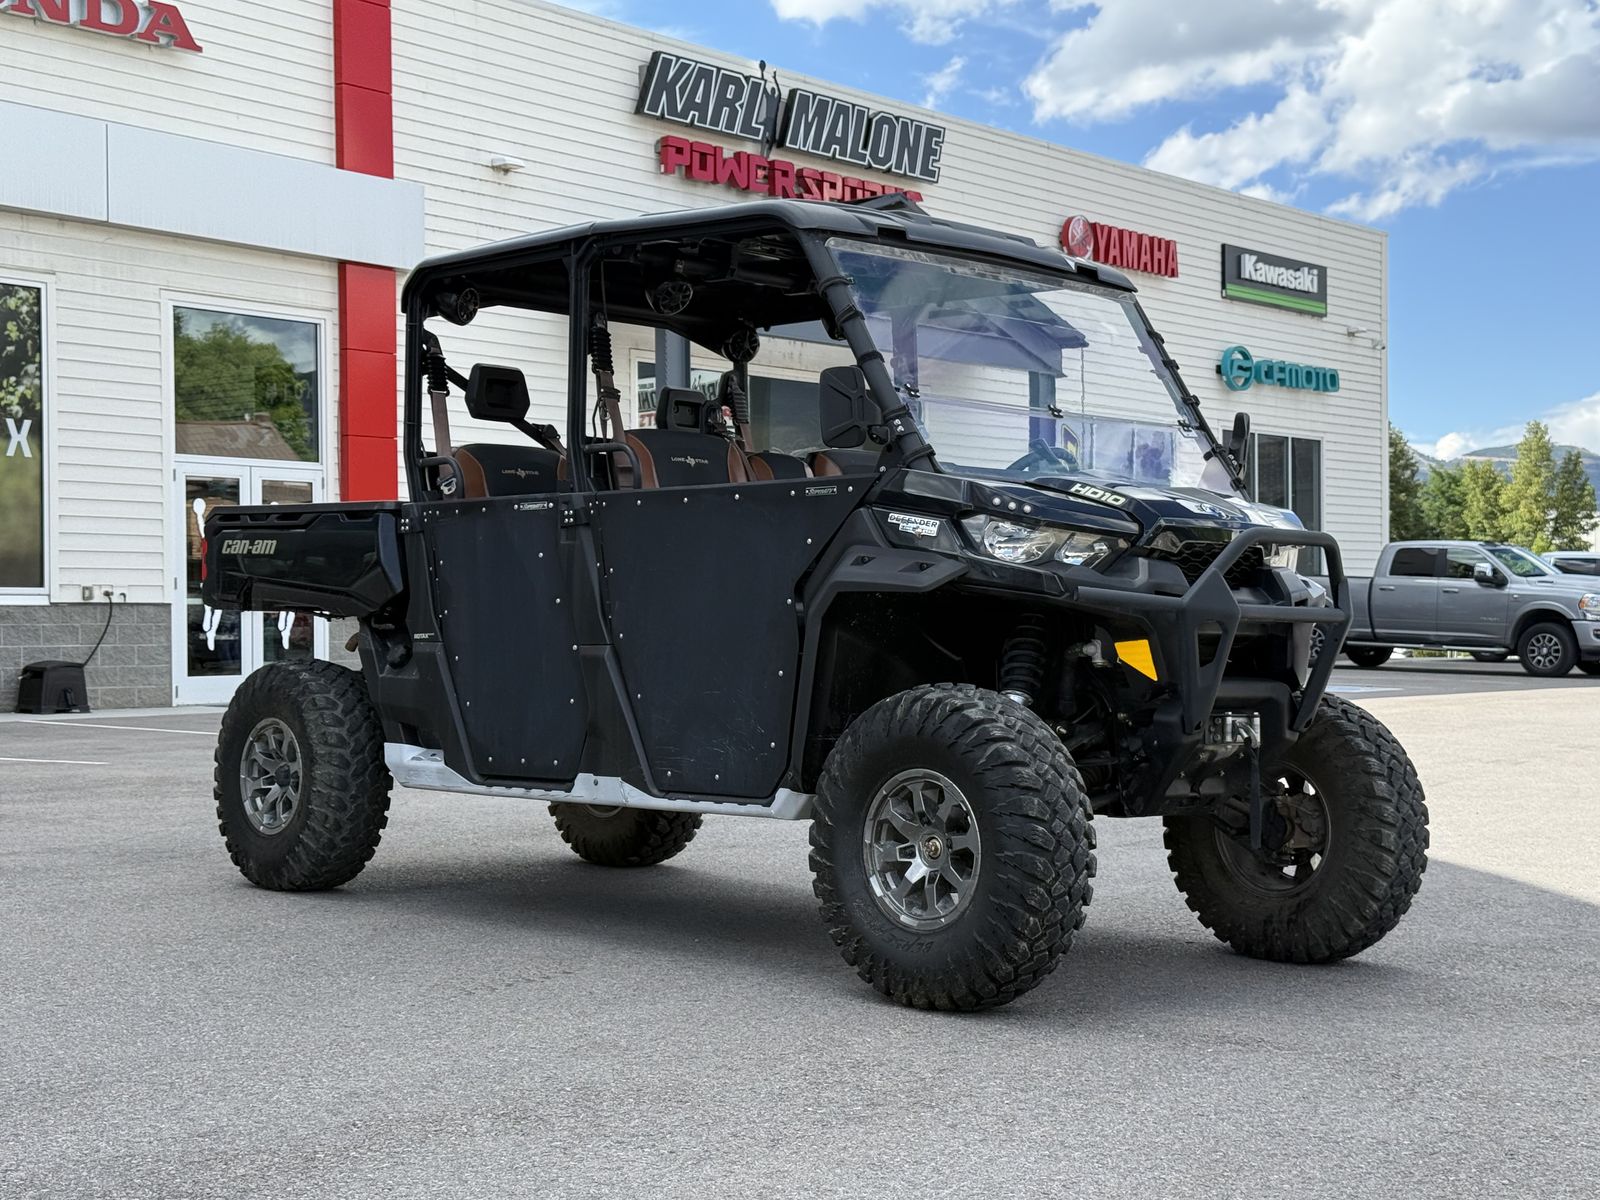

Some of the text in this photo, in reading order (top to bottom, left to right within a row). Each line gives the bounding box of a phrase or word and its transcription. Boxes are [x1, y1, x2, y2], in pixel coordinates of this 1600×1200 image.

[0, 0, 203, 53] NDA
[642, 52, 946, 183] KARL MALONE
[658, 135, 923, 202] POWERSPO
[1092, 222, 1178, 277] YAMAHA
[1240, 253, 1318, 293] Kawasaki
[1257, 360, 1340, 392] CFMOTO
[5, 417, 33, 458] X
[1070, 483, 1126, 505] HD10
[221, 539, 277, 555] can-am
